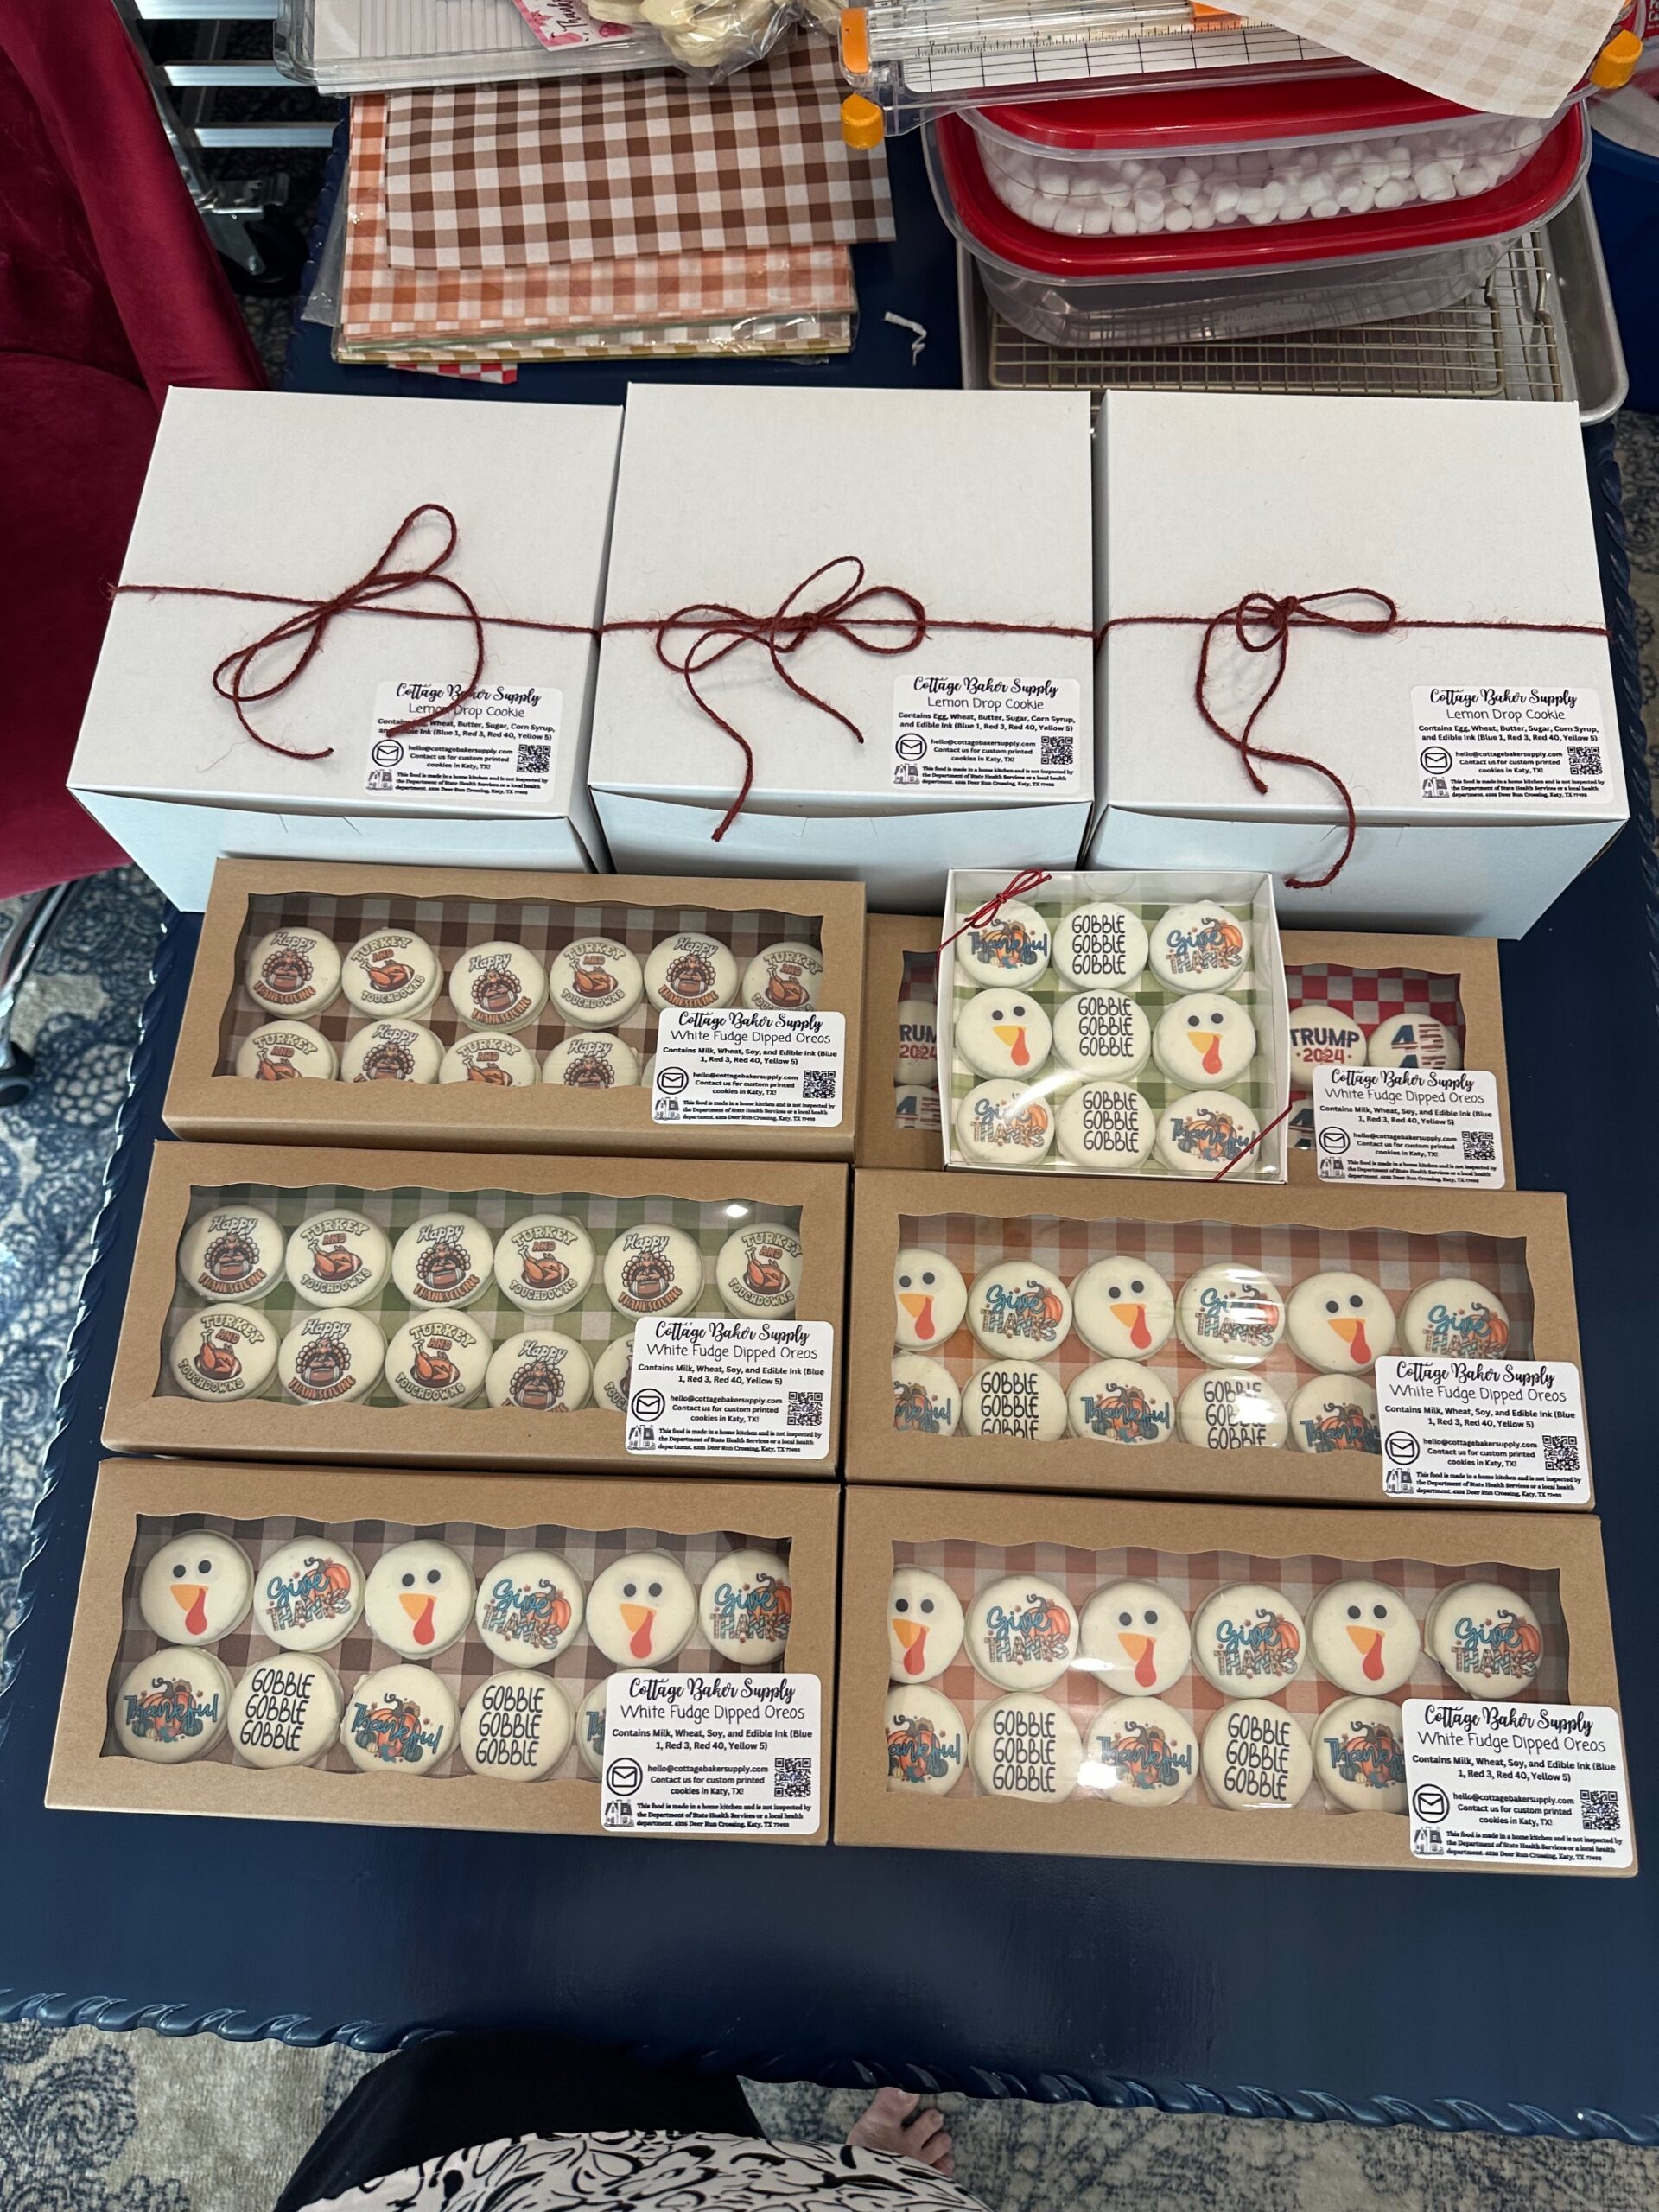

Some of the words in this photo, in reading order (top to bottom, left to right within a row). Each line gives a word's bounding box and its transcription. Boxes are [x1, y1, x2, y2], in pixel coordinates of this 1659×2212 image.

[397, 683, 444, 702] Cottage
[493, 686, 542, 707] Supply
[913, 676, 962, 696] Cottage
[963, 677, 1008, 695] Baker
[1010, 678, 1058, 698] Supply
[927, 696, 969, 708] Lemon
[973, 697, 1001, 713] Drop
[1005, 698, 1044, 709] Cookie
[1430, 689, 1478, 708] Cottage
[1480, 689, 1527, 706] Baker
[1529, 689, 1577, 709] Supply
[452, 702, 483, 721] Drop
[486, 706, 524, 718] Cookie
[1446, 709, 1490, 719] Lemon
[1492, 709, 1522, 723] Drop
[1526, 709, 1566, 720] Cookie
[1072, 915, 1126, 934] GOBBLE
[271, 931, 317, 951] Happy
[351, 936, 413, 963] TURKEY
[967, 931, 1047, 957] Thankful
[1072, 935, 1126, 954] GOBBLE
[1166, 929, 1224, 956] Give
[373, 949, 394, 962] AND
[1072, 954, 1127, 975] GOBBLE
[1166, 946, 1243, 975] THANKS
[361, 976, 425, 1003] TOUCHDOWNS
[1077, 997, 1132, 1016] GOBBLE
[678, 1011, 727, 1031] Cottage
[728, 1012, 773, 1029] Baker
[775, 1013, 823, 1033] Supply
[1078, 1016, 1133, 1037] GOBBLE
[671, 1030, 709, 1040] White
[714, 1030, 748, 1046] Fudge
[752, 1032, 791, 1046] Dipped
[796, 1033, 831, 1044] Oreos
[1079, 1036, 1134, 1057] GOBBLE
[1290, 1027, 1360, 1048] TRUMP
[1303, 1048, 1344, 1064] 2024
[1331, 1068, 1378, 1089] Cottage
[1380, 1070, 1425, 1088] Baker
[1427, 1071, 1474, 1092] Supply
[1083, 1090, 1138, 1111] GOBBLE
[1325, 1088, 1364, 1099] White
[1367, 1089, 1402, 1105] Fudge
[1405, 1090, 1446, 1106] Dipped
[1449, 1092, 1484, 1103] Oreos
[1083, 1111, 1139, 1131] GOBBLE
[970, 1118, 1045, 1147] THANKS
[1084, 1131, 1139, 1153] GOBBLE
[208, 1215, 257, 1235] Happy
[302, 1218, 369, 1242] TURKEY
[322, 1233, 346, 1245] AND
[301, 1268, 372, 1294] TOUCHDOWNS
[986, 1284, 1046, 1314] Give
[655, 1320, 707, 1344] Cottage
[709, 1322, 757, 1342] Baker
[759, 1323, 810, 1346] Supply
[980, 1309, 1058, 1341] THANKS
[646, 1344, 688, 1356] White
[693, 1344, 729, 1362] Fudge
[734, 1345, 776, 1363] Dipped
[780, 1346, 818, 1359] Oreos
[1396, 1361, 1449, 1385] Cottage
[1451, 1363, 1501, 1383] Baker
[1503, 1364, 1555, 1389] Supply
[1389, 1384, 1433, 1398] White
[1437, 1385, 1476, 1404] Fudge
[1479, 1387, 1523, 1405] Dipped
[1528, 1389, 1567, 1402] Oreos
[1080, 1396, 1169, 1429] Thankful
[267, 1573, 330, 1607] Give
[267, 1590, 351, 1631] THANKS
[987, 1605, 1052, 1638] Give
[984, 1633, 1069, 1662] THANKS
[251, 1668, 315, 1699] GOBBLE
[629, 1677, 684, 1704] Cottage
[687, 1677, 739, 1701] Baker
[741, 1677, 796, 1705] Supply
[124, 1694, 219, 1726] Thankful
[245, 1694, 308, 1725] GOBBLE
[620, 1704, 665, 1719] White
[670, 1704, 709, 1725] Fudge
[714, 1705, 760, 1725] Dipped
[765, 1705, 805, 1719] Oreos
[1425, 1704, 1480, 1732] Cottage
[1482, 1707, 1535, 1731] Baker
[1537, 1709, 1593, 1737] Supply
[652, 1729, 673, 1738] Milk,
[675, 1729, 705, 1738] Wheat,
[707, 1729, 726, 1739] Soy,
[727, 1729, 744, 1738] and
[746, 1729, 773, 1738] Edible
[775, 1729, 788, 1738] Ink
[790, 1730, 813, 1738] (Blue
[994, 1710, 1055, 1738] GOBBLE
[240, 1720, 303, 1751] GOBBLE
[656, 1741, 664, 1751] 1,
[665, 1741, 683, 1750] Red
[683, 1741, 692, 1751] 3,
[694, 1741, 710, 1750] Red
[712, 1742, 727, 1751] 40,
[728, 1741, 758, 1750] Yellow
[760, 1742, 768, 1751] 5)
[1417, 1731, 1465, 1746] White
[1467, 1732, 1510, 1754] Fudge
[1512, 1734, 1560, 1755] Dipped
[1564, 1736, 1606, 1752] Oreos
[994, 1738, 1055, 1765] GOBBLE
[1096, 1736, 1192, 1775] Thankful
[647, 1764, 768, 1774] hello@cottagebakersupply.com
[994, 1765, 1056, 1793] GOBBLE
[710, 1788, 730, 1796] Katy,
[736, 1777, 765, 1785] printed
